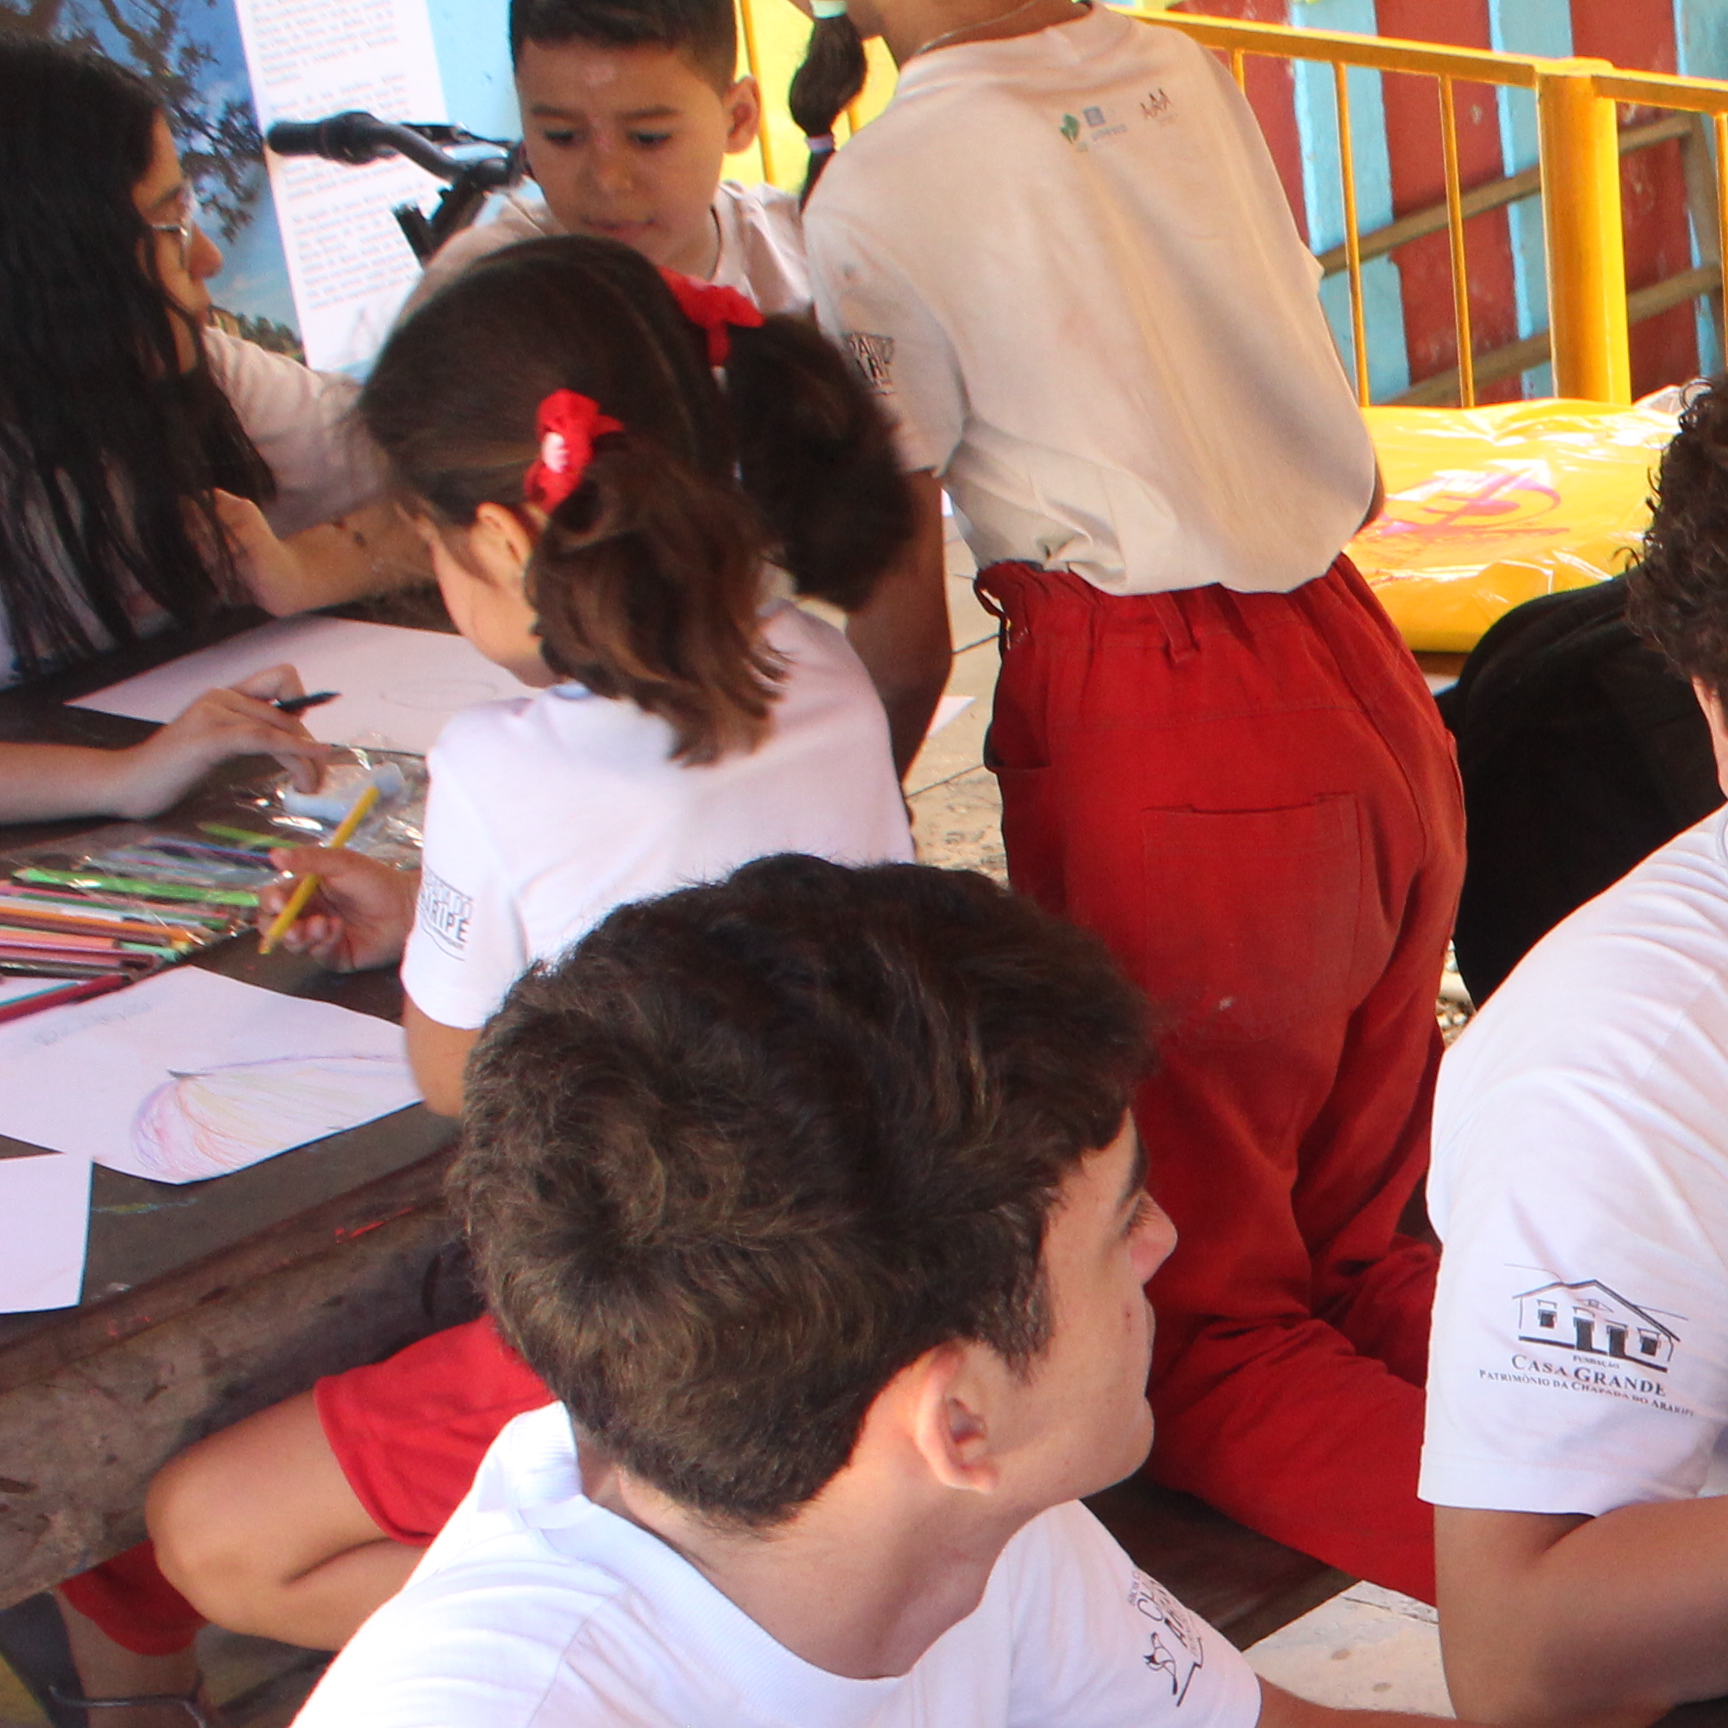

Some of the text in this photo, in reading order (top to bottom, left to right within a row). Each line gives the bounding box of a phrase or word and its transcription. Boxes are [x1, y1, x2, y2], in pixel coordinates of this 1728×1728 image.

[1572, 1354, 1620, 1370] FUNDAÇÃO
[1478, 1368, 1551, 1387] PATRIMÔNIO
[1553, 1380, 1569, 1391] DA
[1511, 1352, 1667, 1398] CASA GRANDE
